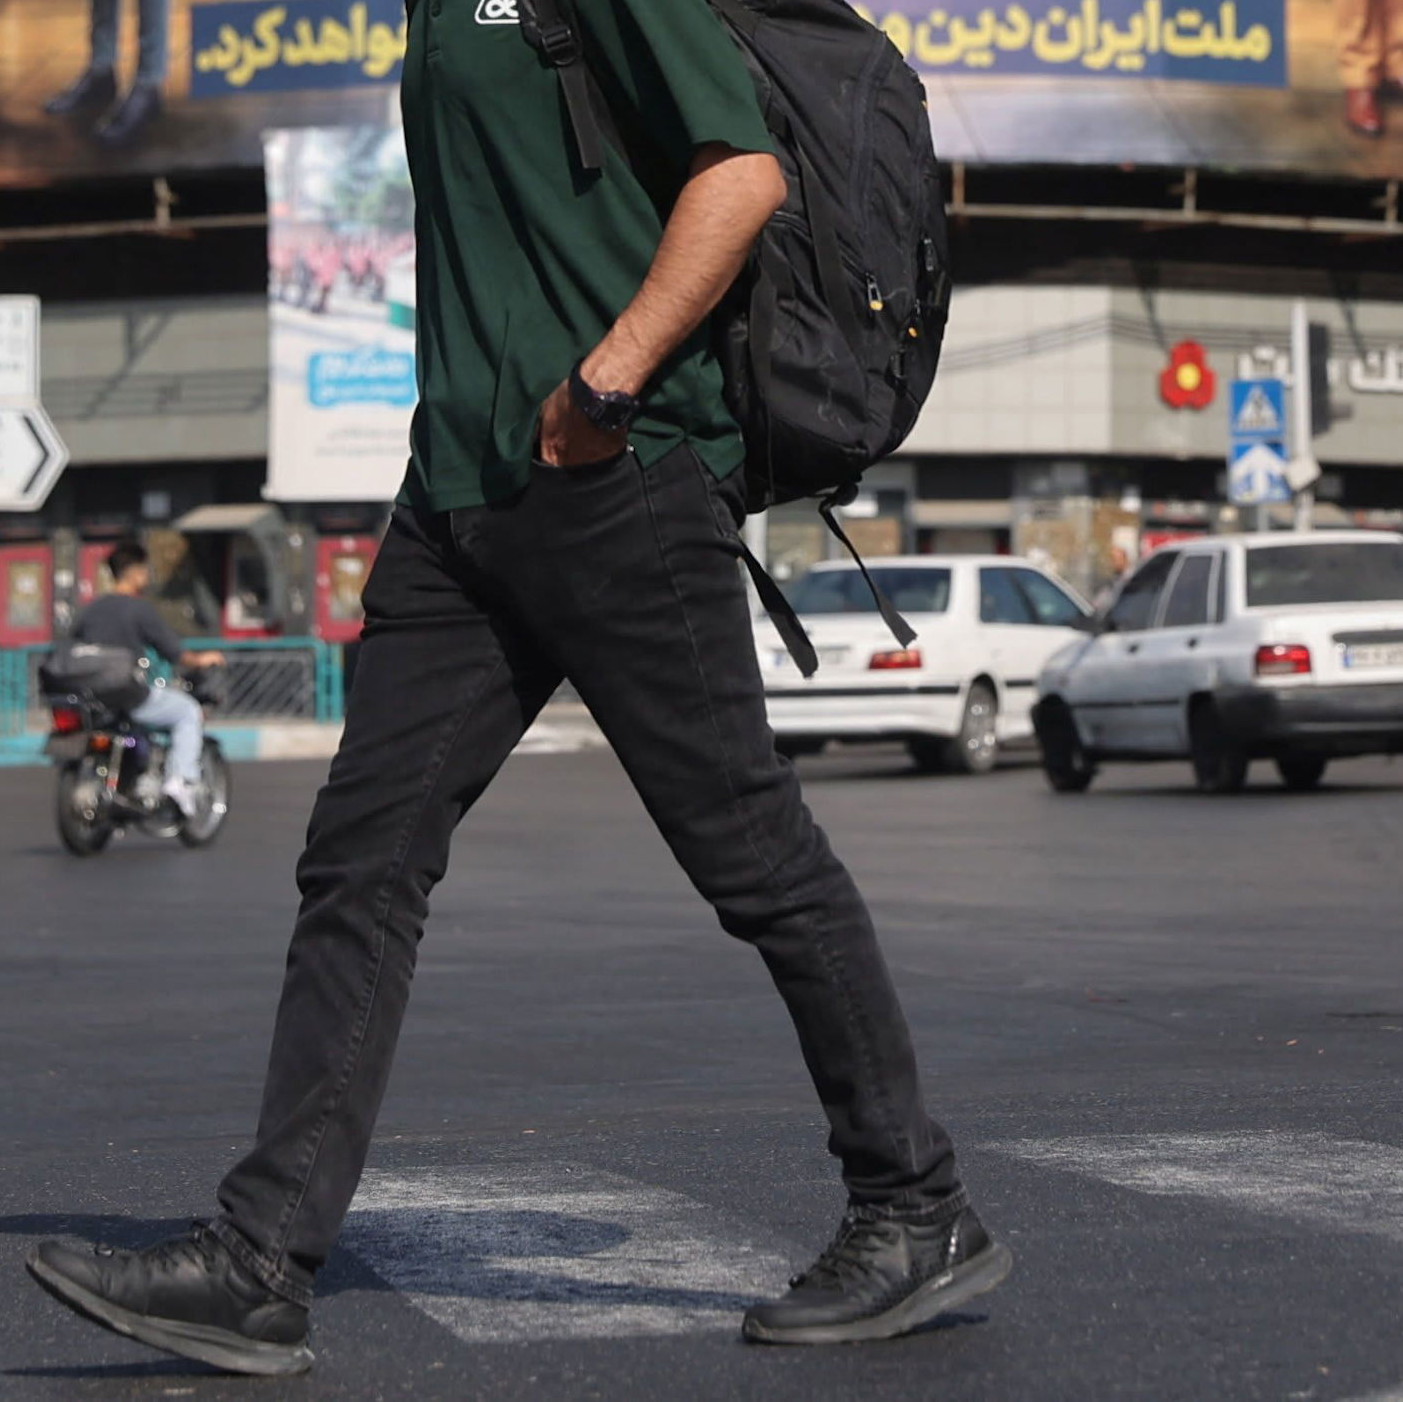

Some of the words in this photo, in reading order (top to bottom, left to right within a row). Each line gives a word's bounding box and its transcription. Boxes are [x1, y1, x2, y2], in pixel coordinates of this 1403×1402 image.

[282, 1, 407, 78] واهد
[914, 4, 1033, 68] دین
[1164, 1, 1272, 62] ملت
